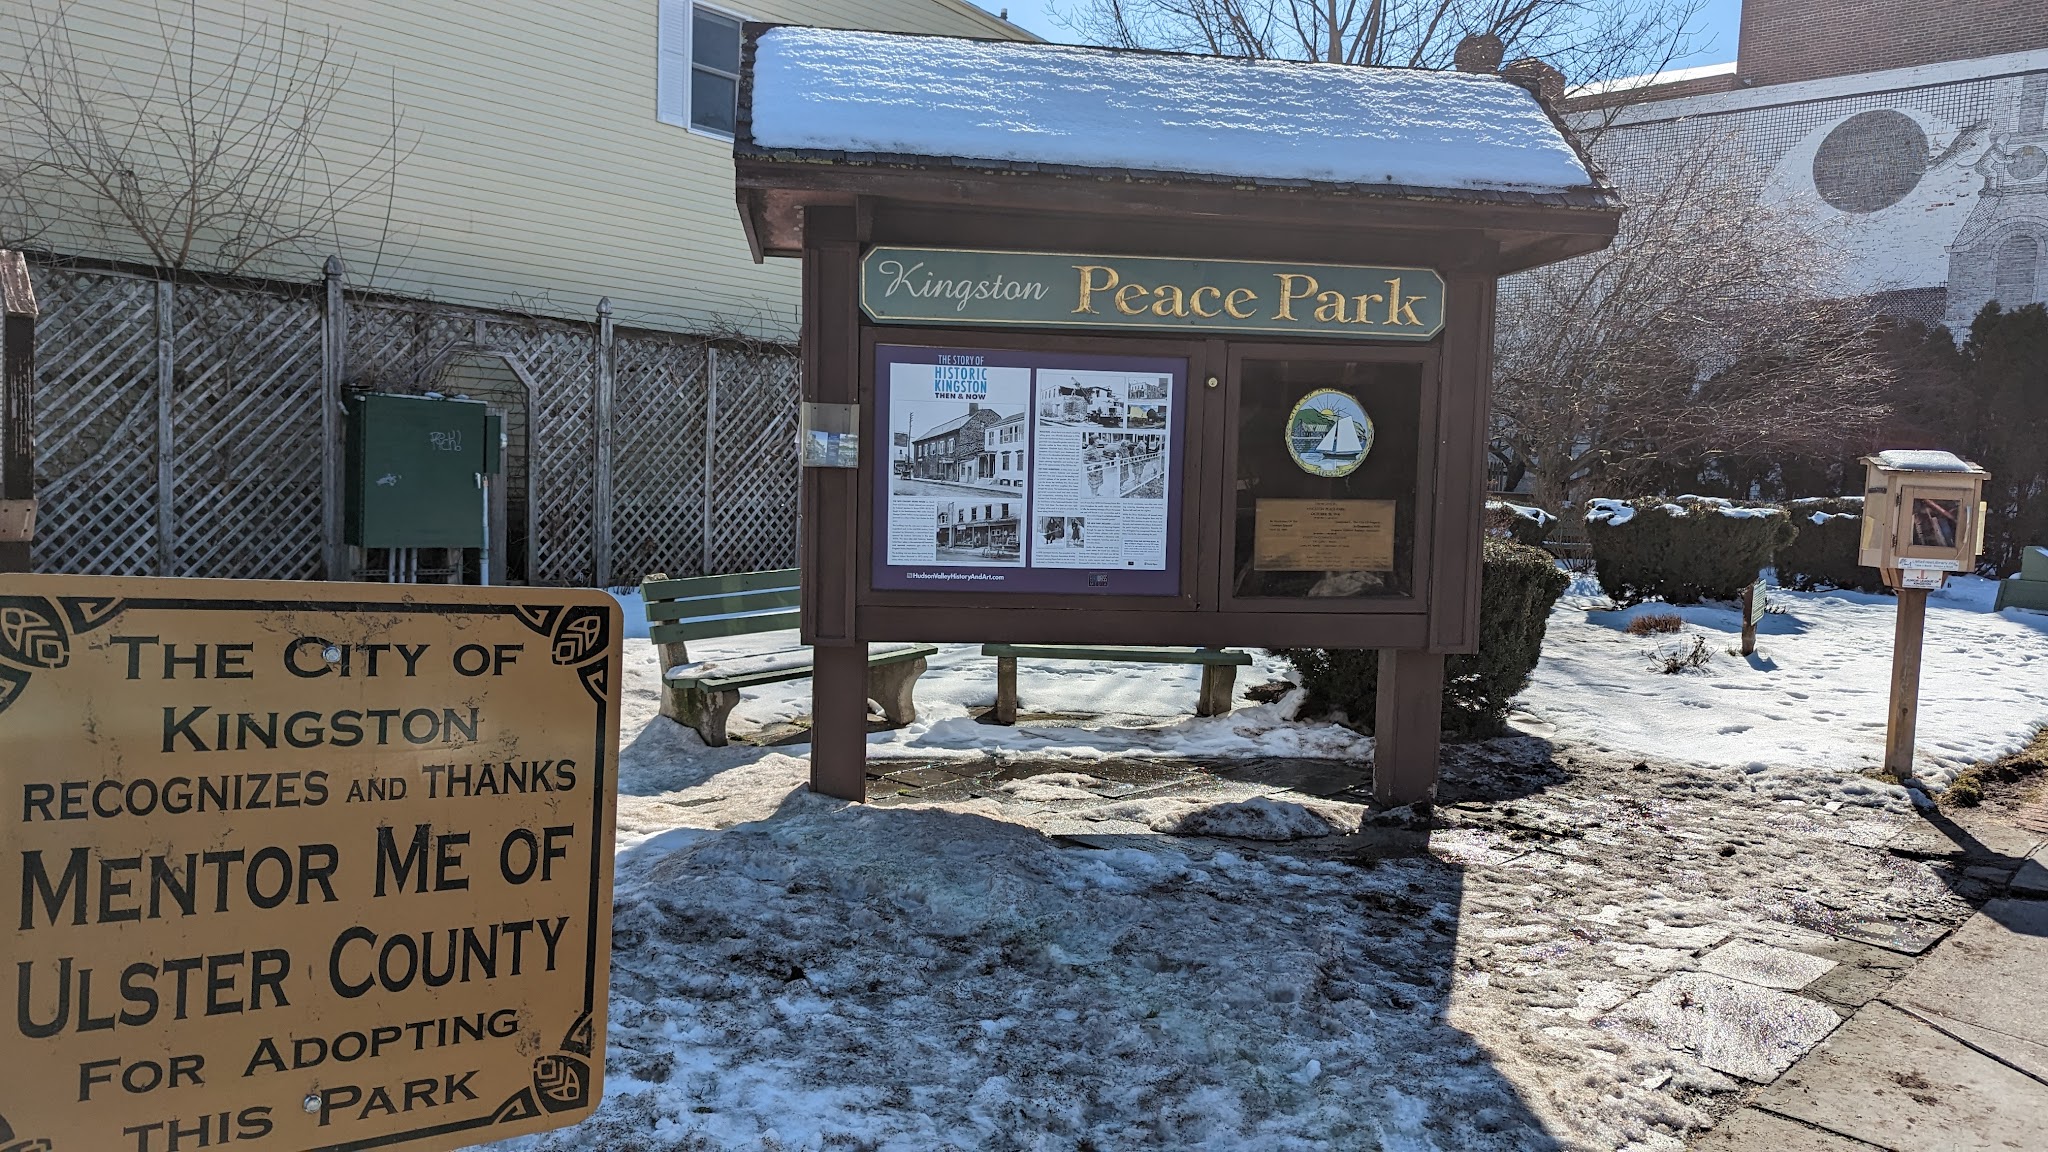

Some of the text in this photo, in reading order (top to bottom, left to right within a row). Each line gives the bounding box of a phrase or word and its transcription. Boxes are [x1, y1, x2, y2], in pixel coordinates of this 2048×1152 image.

[879, 260, 1426, 326] Kingston Peace Park
[934, 379, 987, 393] KINGSTON
[935, 366, 987, 380] HISTORIC
[938, 354, 984, 366] THE STORY OF
[912, 572, 1004, 581] HudsonValleyHistoryAndArt.com
[109, 635, 525, 680] THE CITY OF
[161, 705, 480, 753] KINGSTON
[22, 759, 577, 822] RECOGNIZES AND THANKS
[18, 823, 575, 931] MENTOR ME OF
[17, 917, 570, 1039] ULSTER COUNTY
[78, 1009, 520, 1102] FOR ADOPTING
[123, 1070, 480, 1152] THIS PARK
